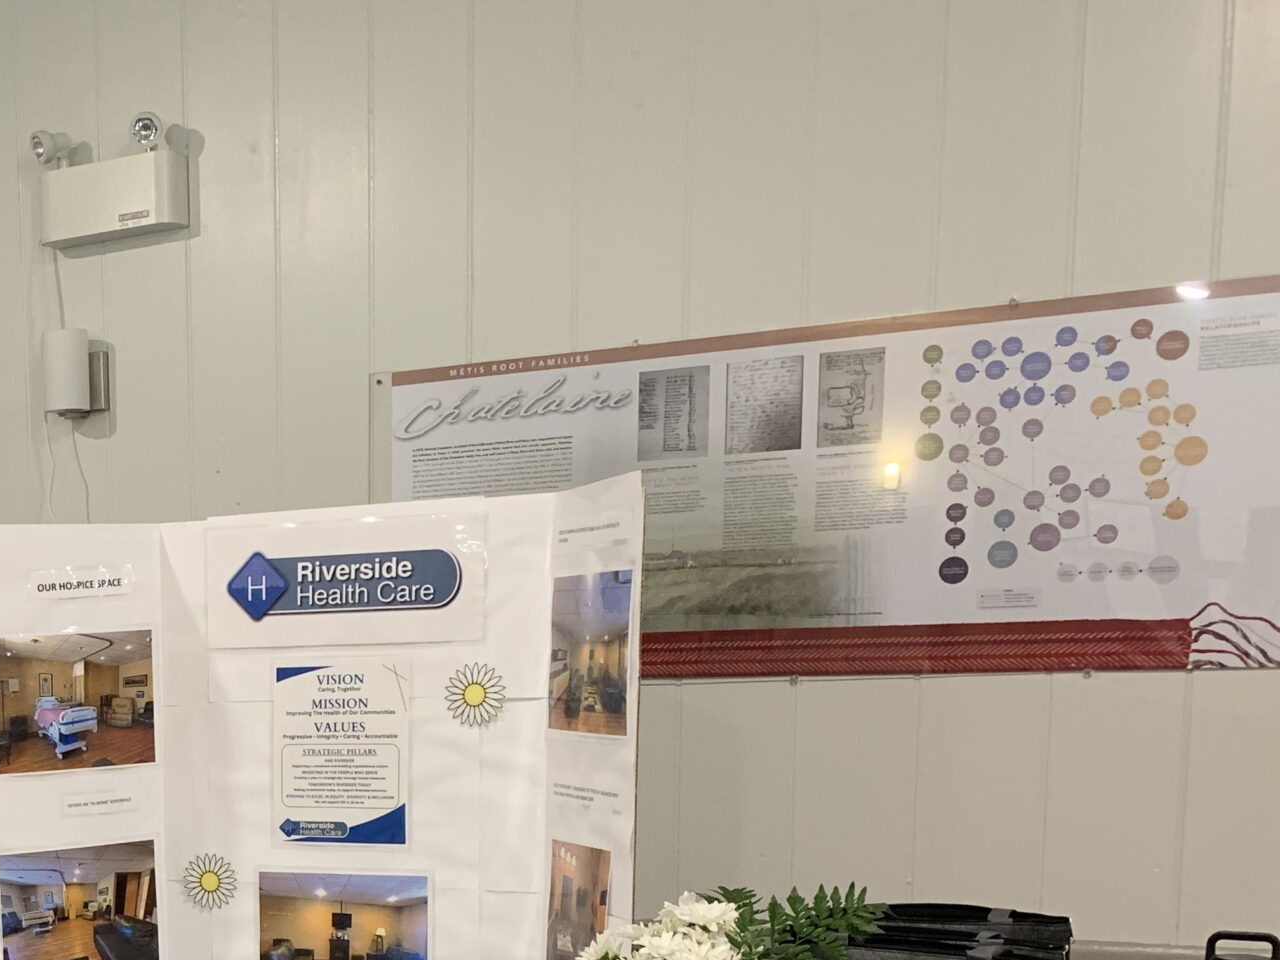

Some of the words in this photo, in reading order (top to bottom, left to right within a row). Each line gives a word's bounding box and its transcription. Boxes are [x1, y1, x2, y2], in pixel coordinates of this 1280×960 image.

[492, 361, 523, 371] ROOT
[532, 354, 590, 367] FAMILIES
[395, 371, 634, 441] Chatelaine
[297, 557, 413, 583] Riverside
[37, 583, 57, 592] OUR
[247, 576, 266, 601] H
[297, 584, 368, 606] Health
[376, 581, 435, 603] Care
[316, 674, 364, 685] VISION
[312, 698, 368, 709] MISSION
[314, 722, 366, 732] VALUES
